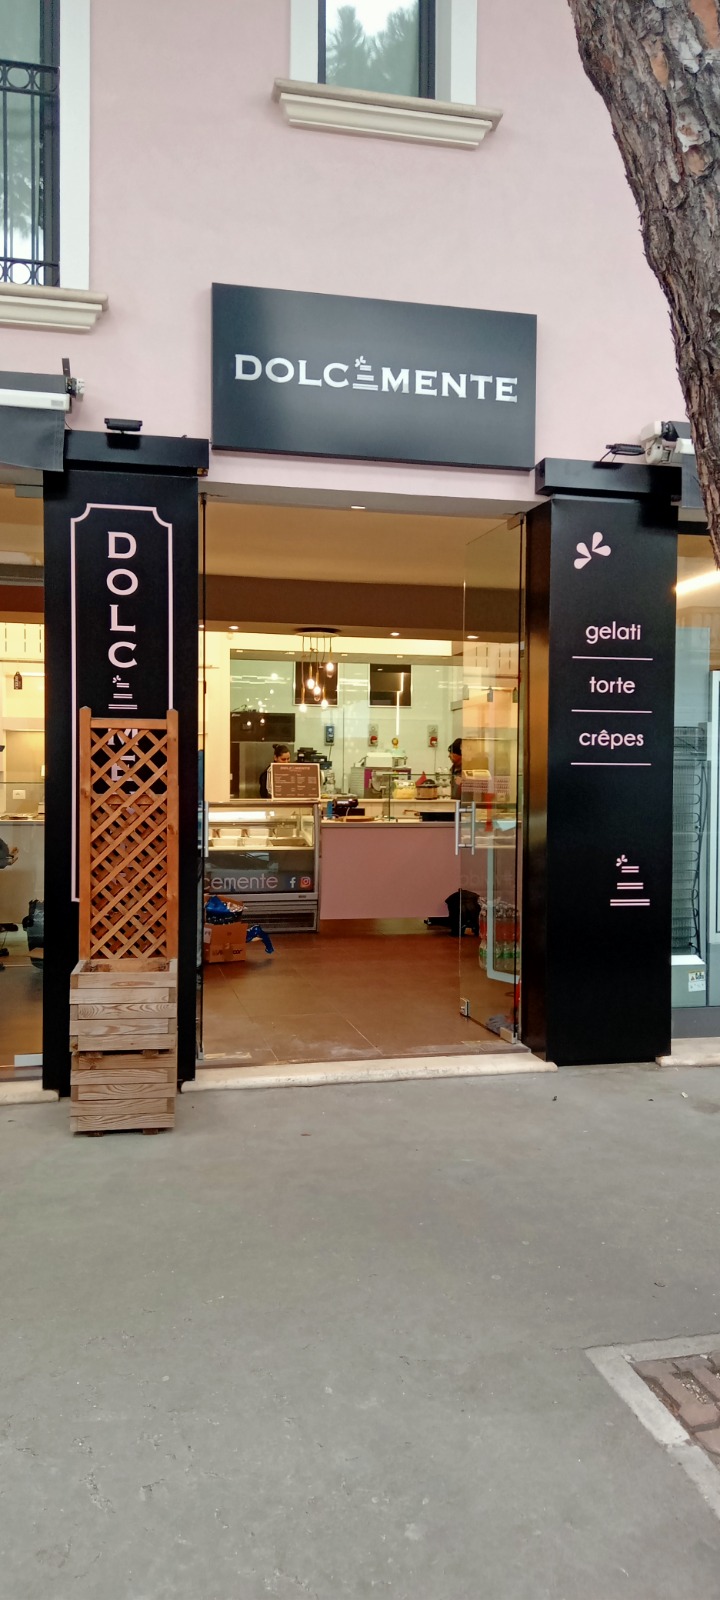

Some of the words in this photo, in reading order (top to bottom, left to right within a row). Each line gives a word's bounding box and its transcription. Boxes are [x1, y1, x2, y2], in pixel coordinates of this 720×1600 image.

[585, 620, 642, 645] gelati
[588, 676, 636, 694] torte
[578, 729, 644, 750] crêpes
